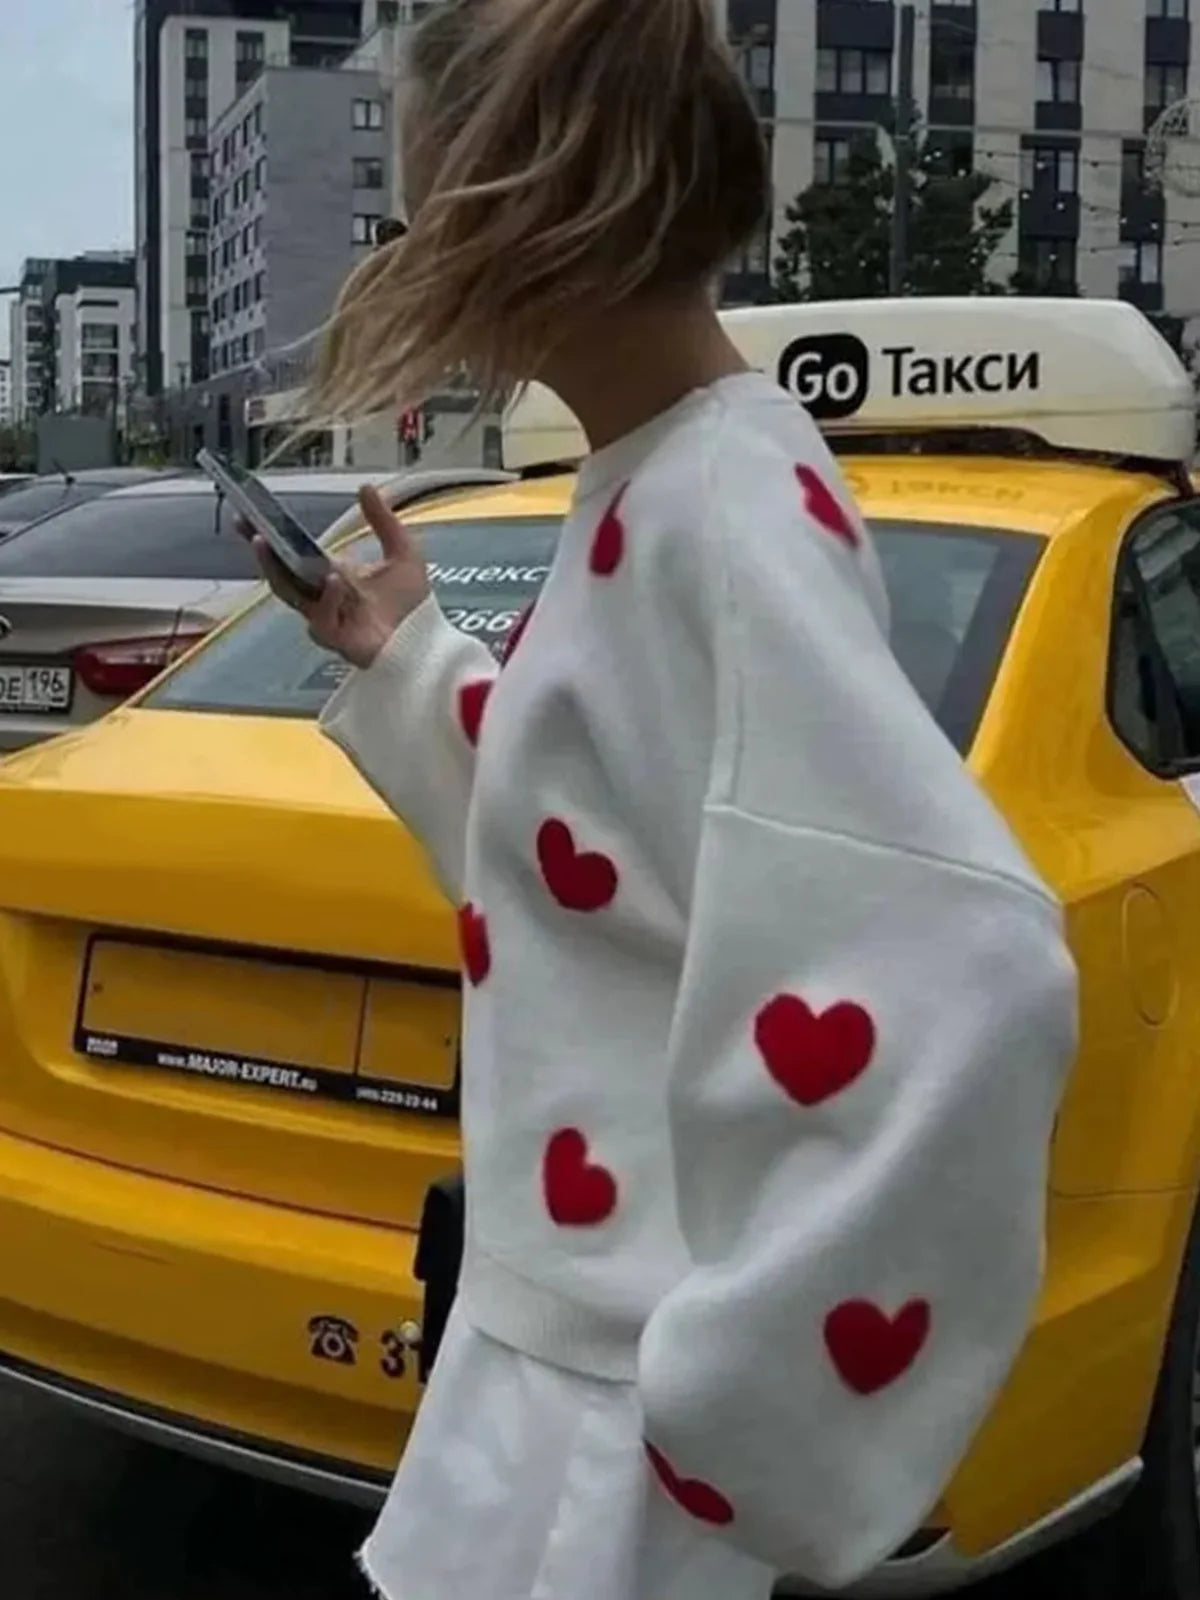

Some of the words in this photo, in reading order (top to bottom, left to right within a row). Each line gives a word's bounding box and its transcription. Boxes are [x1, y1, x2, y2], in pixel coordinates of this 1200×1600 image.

[787, 352, 859, 403] Go
[881, 345, 1039, 397] Такси
[28, 671, 64, 693] 196
